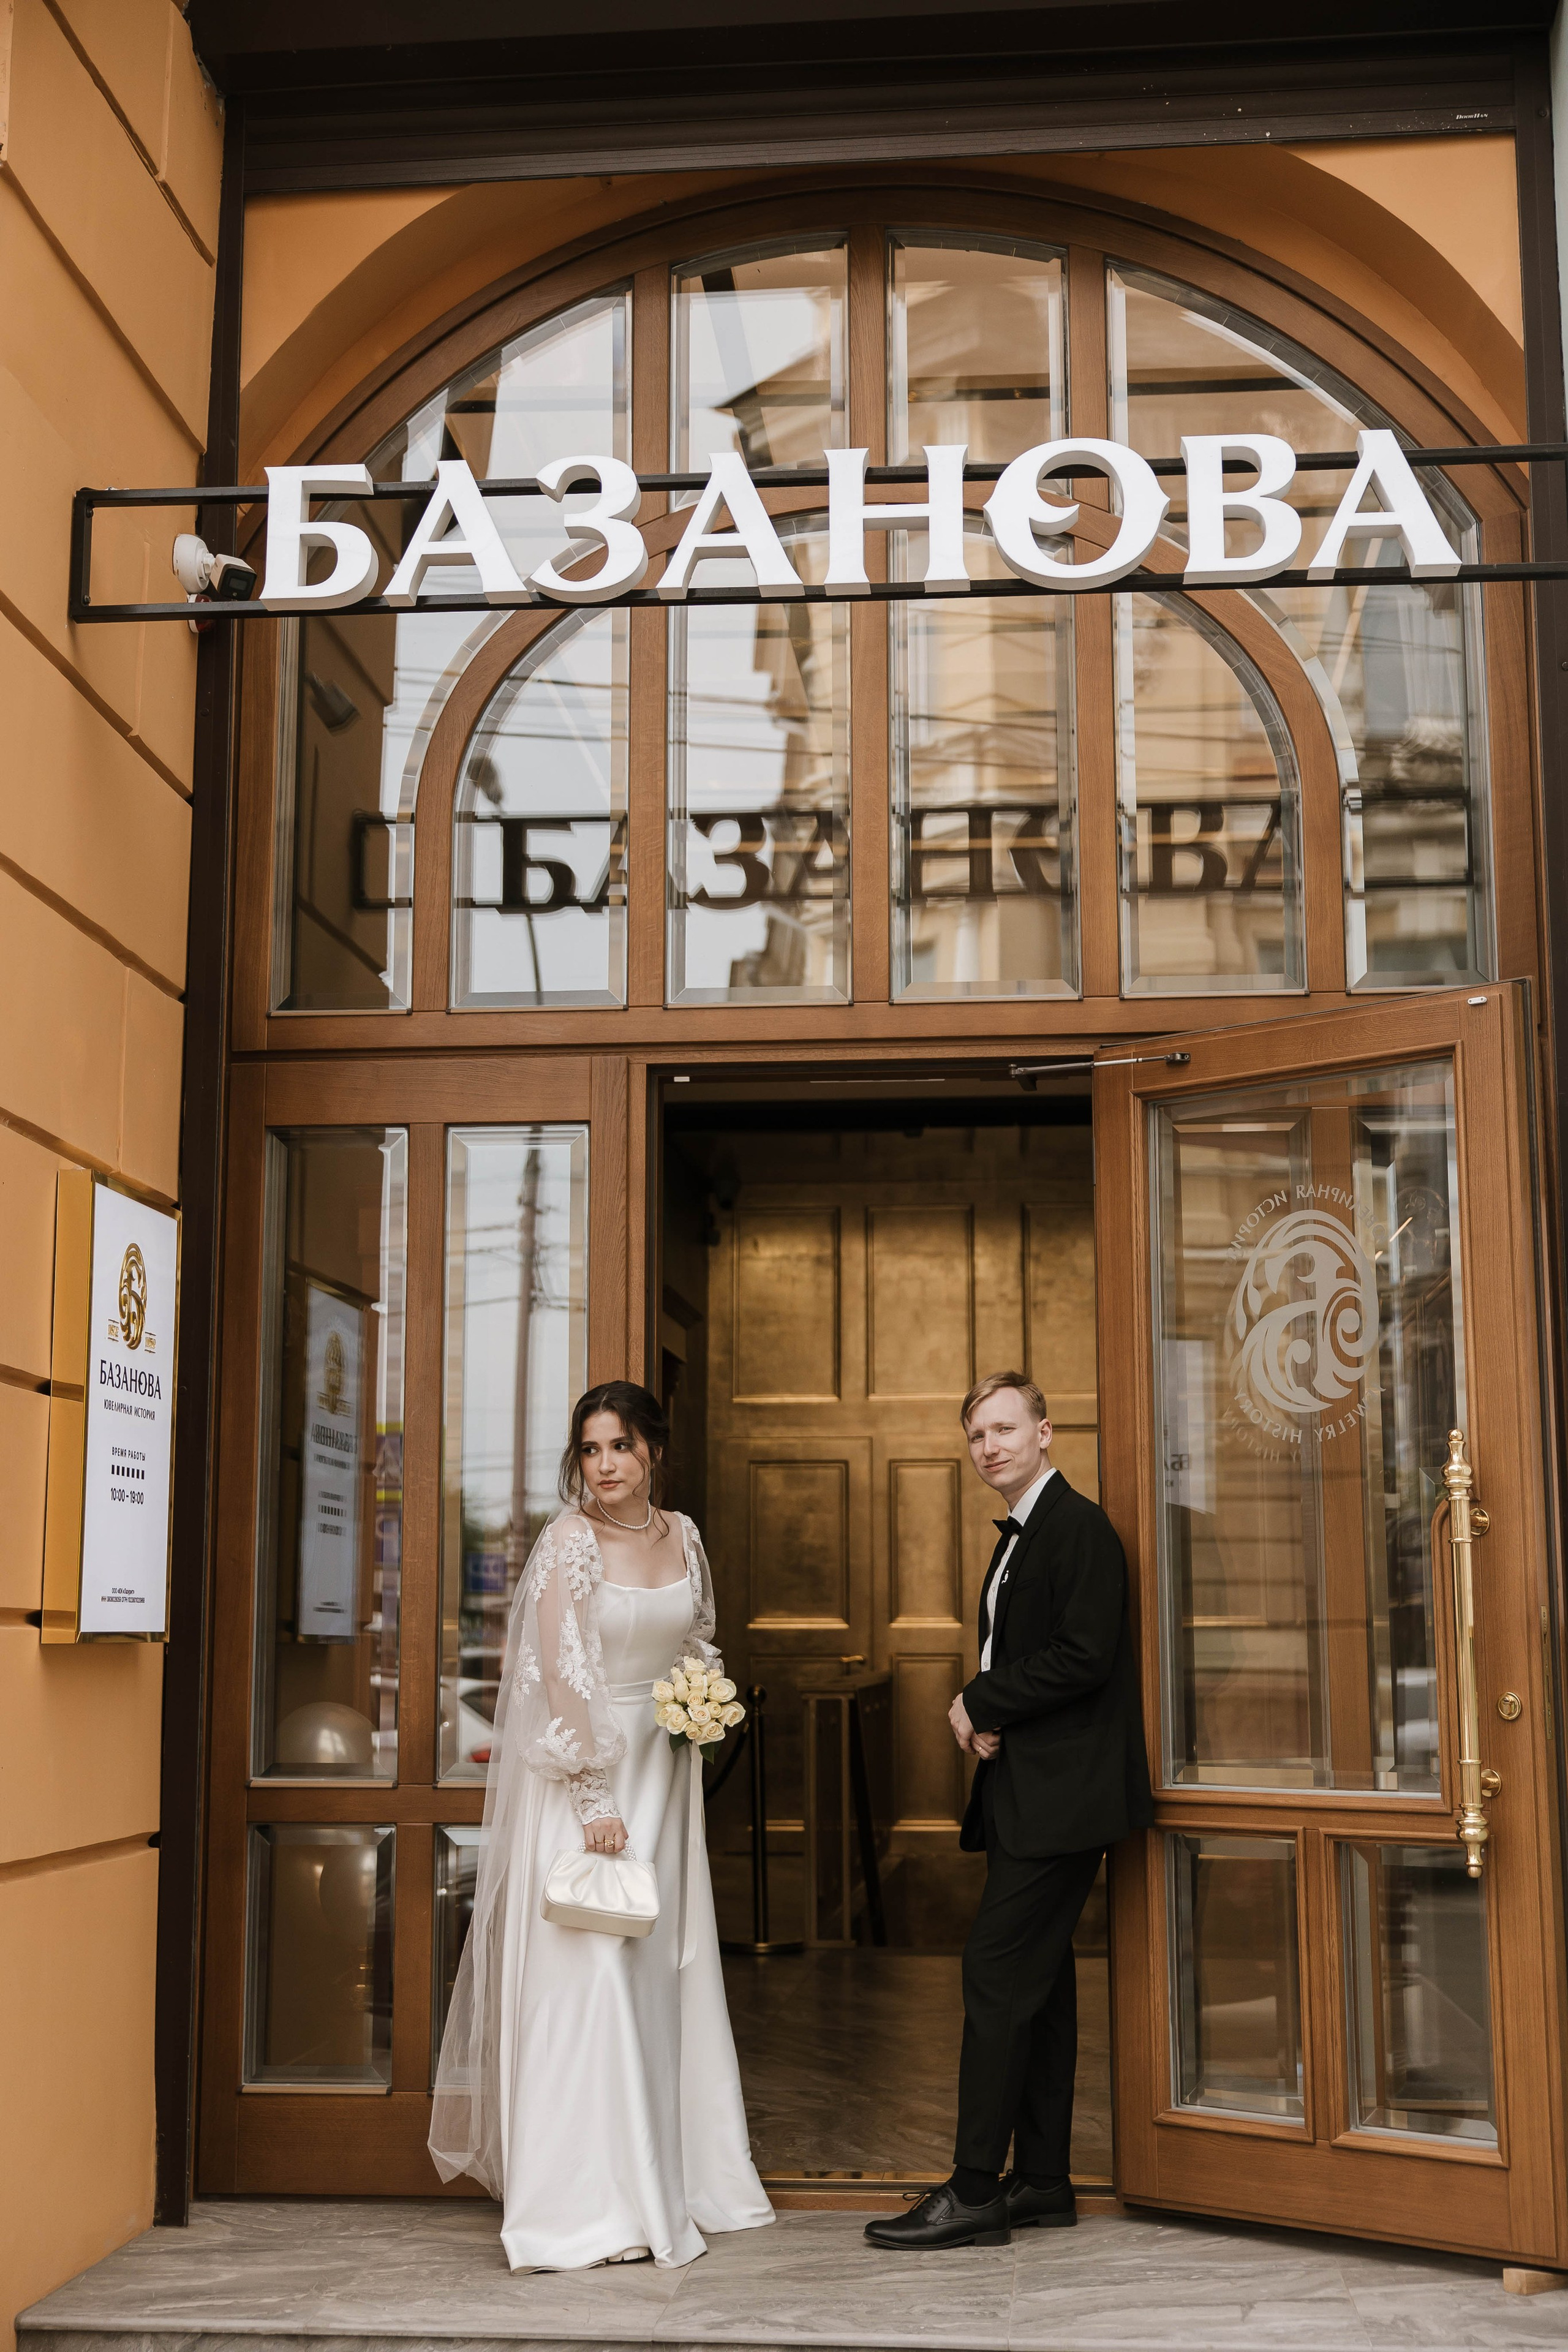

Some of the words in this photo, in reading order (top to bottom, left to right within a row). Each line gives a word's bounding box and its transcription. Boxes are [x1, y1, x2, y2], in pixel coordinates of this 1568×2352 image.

[260, 428, 1463, 610] БАЗАНОВА
[100, 1359, 161, 1400] БАЗАНОВА
[104, 1399, 132, 1415] ЮВЕЛИРНАЯ
[134, 1406, 156, 1420] ИСТОРИЯ
[112, 1446, 127, 1458] ВРЕМЯ
[128, 1450, 146, 1461] РАБОТЫ
